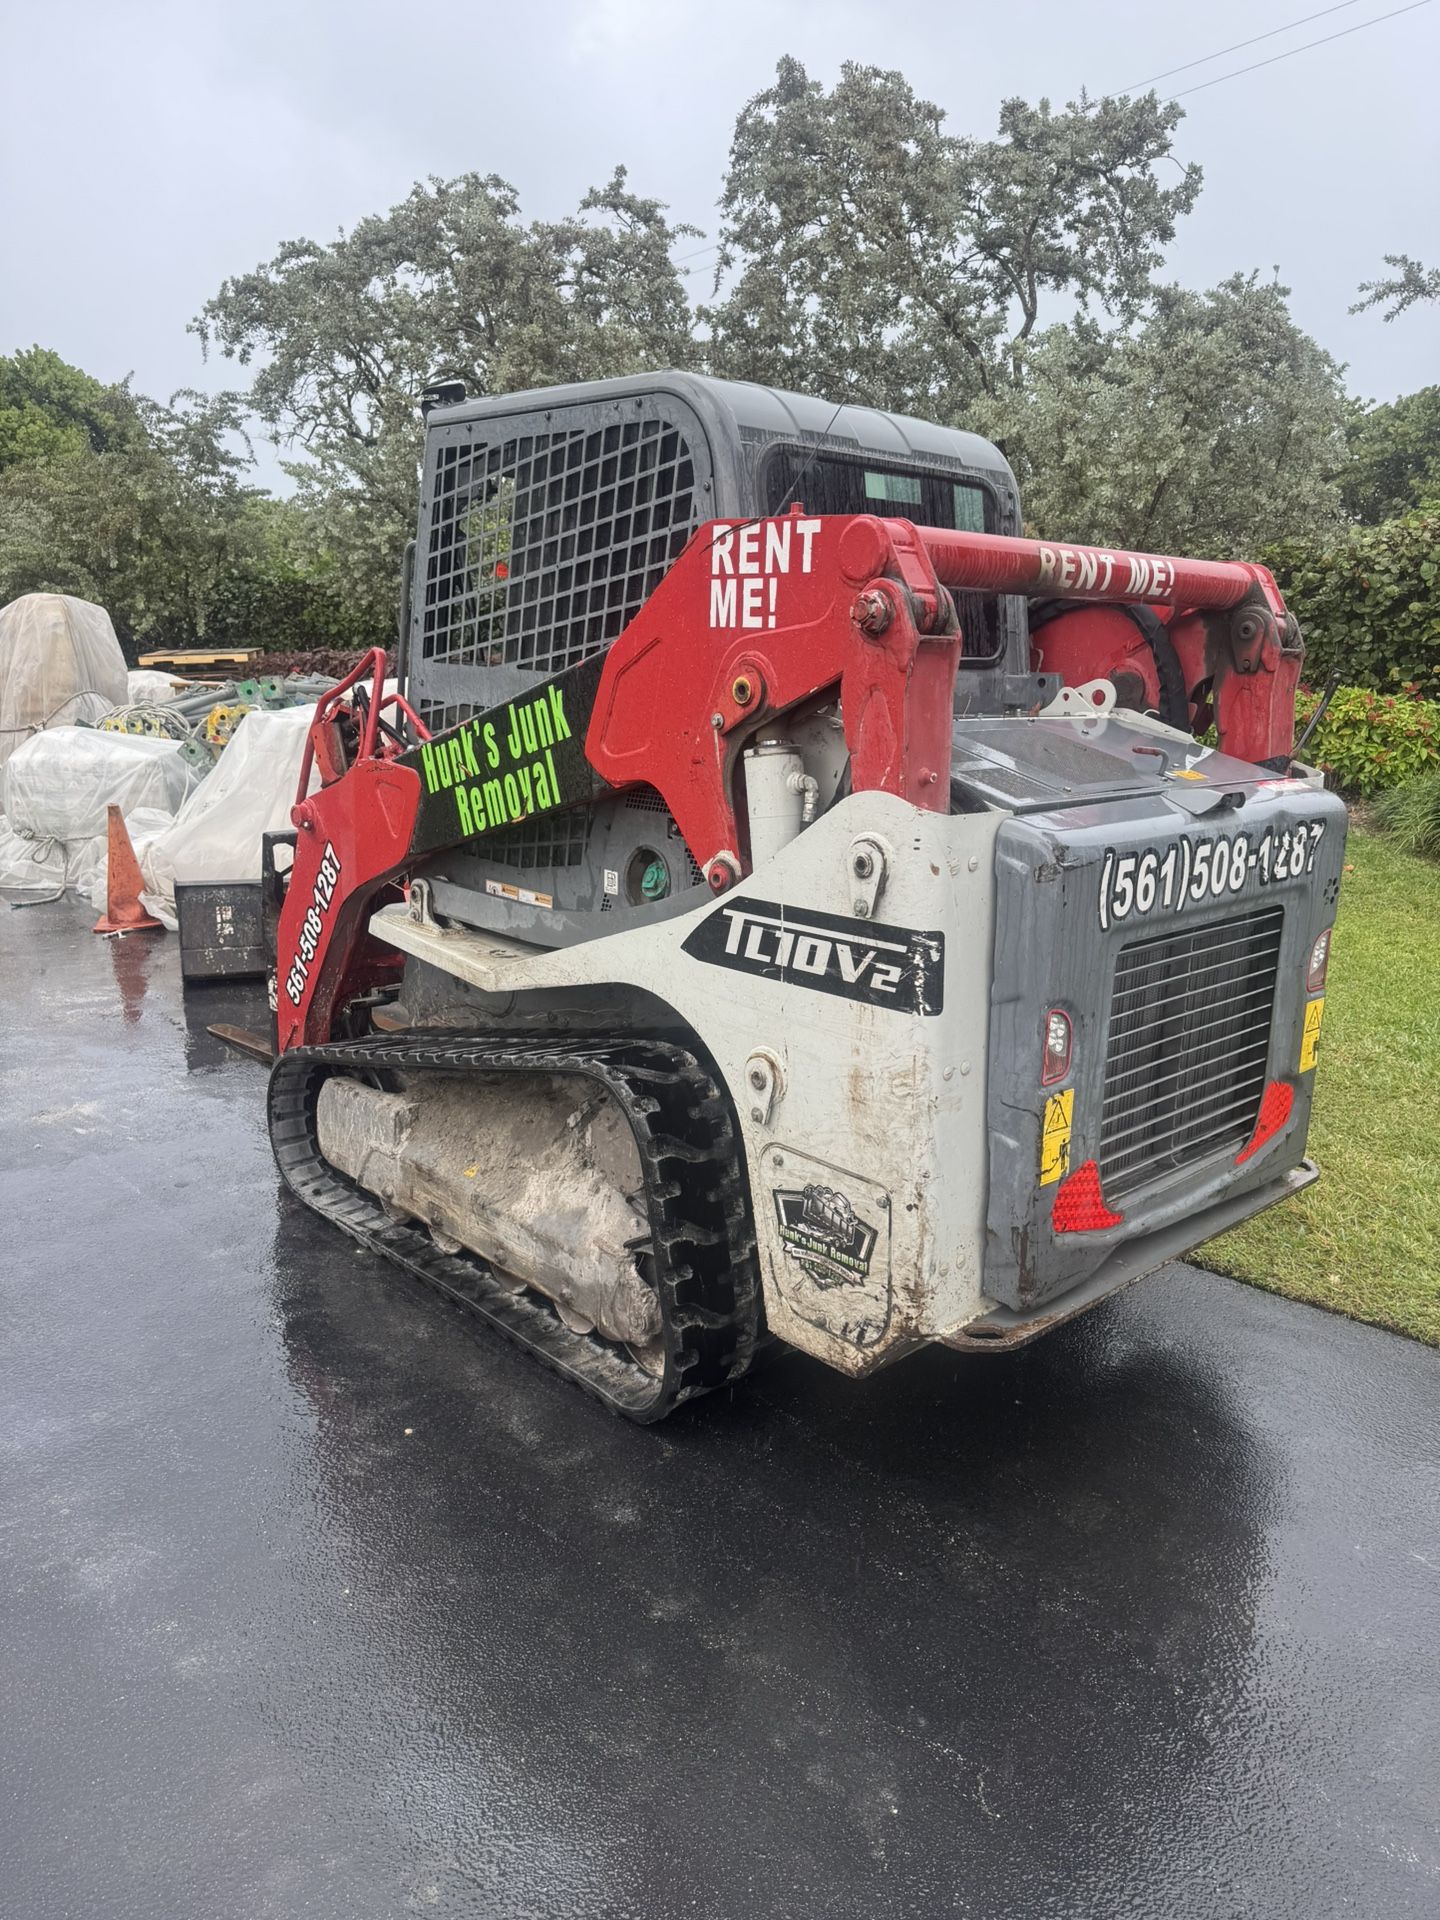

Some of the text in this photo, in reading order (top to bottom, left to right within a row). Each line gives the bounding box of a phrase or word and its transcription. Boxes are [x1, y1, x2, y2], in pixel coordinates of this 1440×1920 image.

[711, 519, 821, 575] RENT
[1037, 547, 1175, 596] RENT ME!
[710, 577, 777, 628] ME!
[422, 684, 572, 794] Hunk's Junk
[455, 749, 561, 836] Removal
[285, 841, 342, 1006] 561-508-1287
[830, 1247, 868, 1273] Removal
